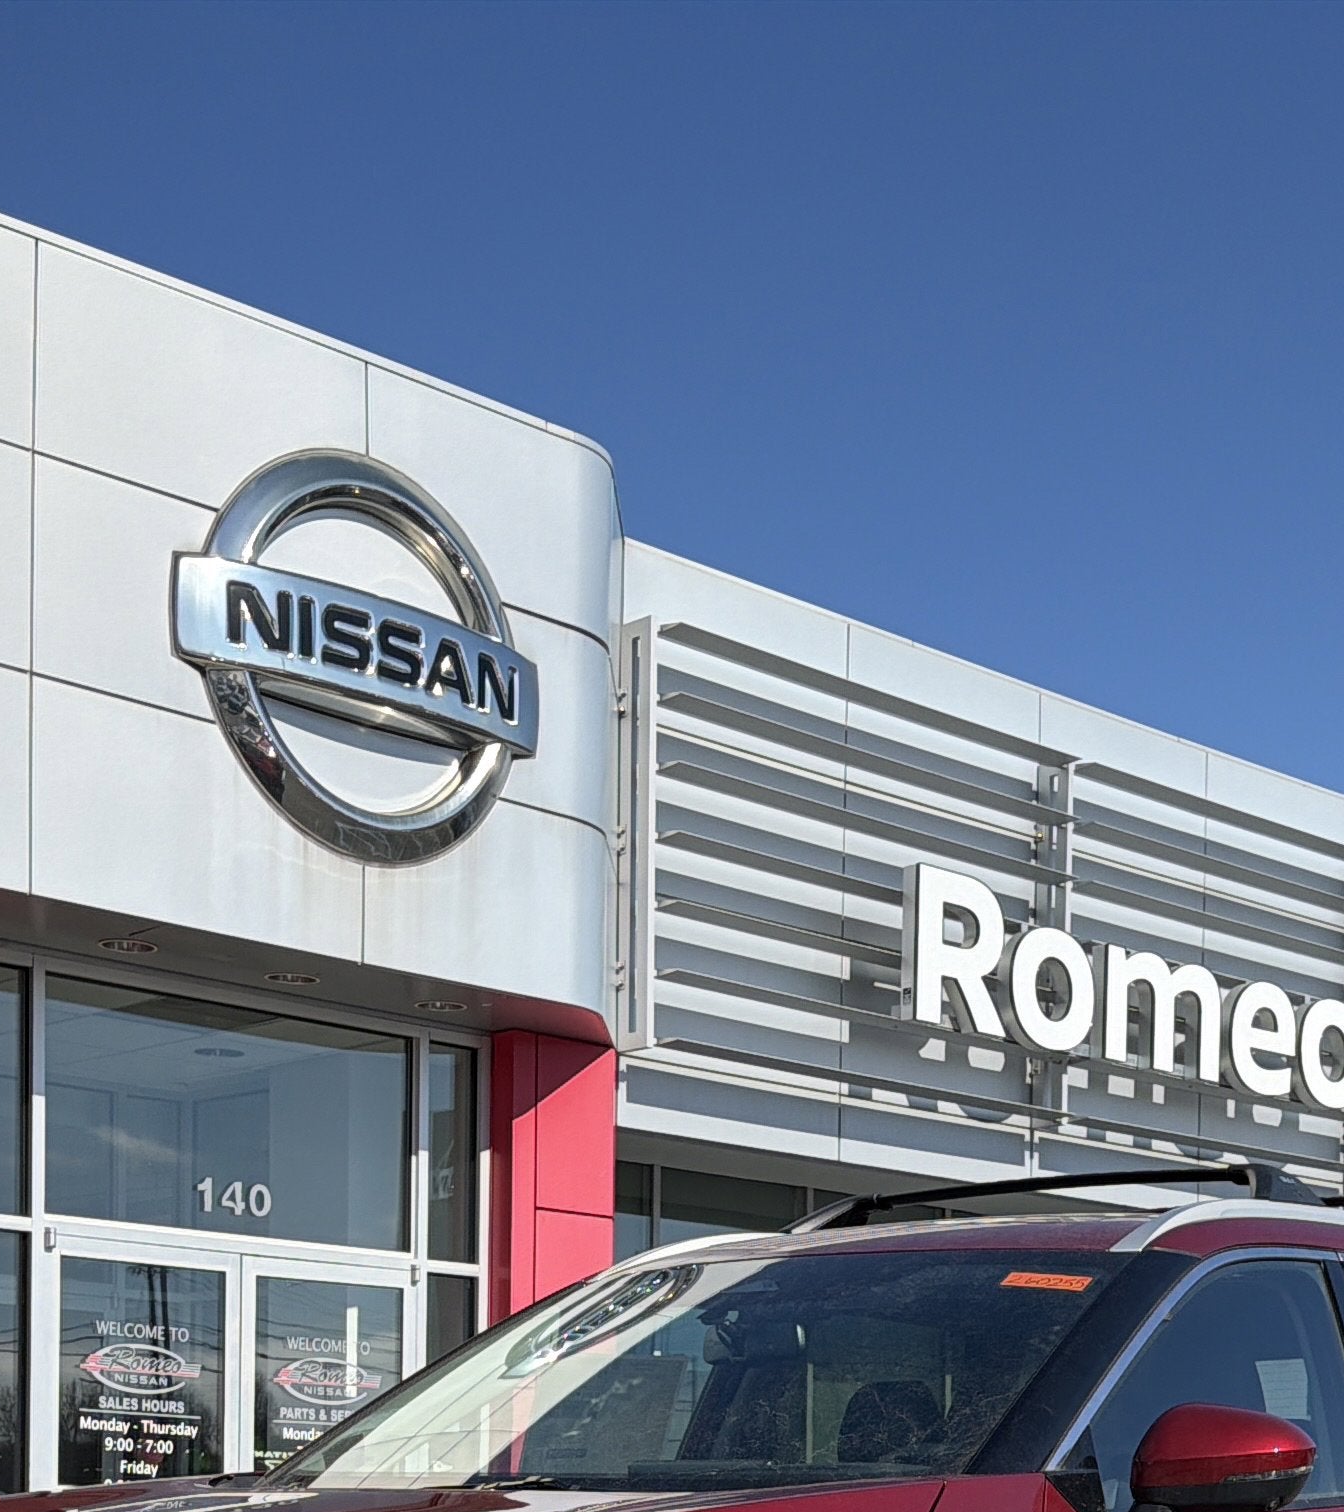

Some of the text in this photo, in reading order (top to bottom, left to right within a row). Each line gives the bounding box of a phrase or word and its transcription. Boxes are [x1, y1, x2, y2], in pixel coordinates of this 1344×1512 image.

[225, 580, 520, 725] NISSAN
[197, 1176, 272, 1217] 140
[96, 1320, 189, 1342] WELCOME TO
[102, 1346, 182, 1374] Romeo
[114, 1373, 168, 1386] NISSAN
[98, 1395, 185, 1414] SALES HOURS
[279, 1406, 316, 1421] PARTS
[319, 1408, 328, 1421] &
[79, 1416, 130, 1435] Monday
[141, 1420, 199, 1439] Thursday
[282, 1427, 324, 1441] Monda
[104, 1437, 134, 1452] 9:00
[145, 1439, 174, 1454] 7:00
[120, 1461, 158, 1477] Friday
